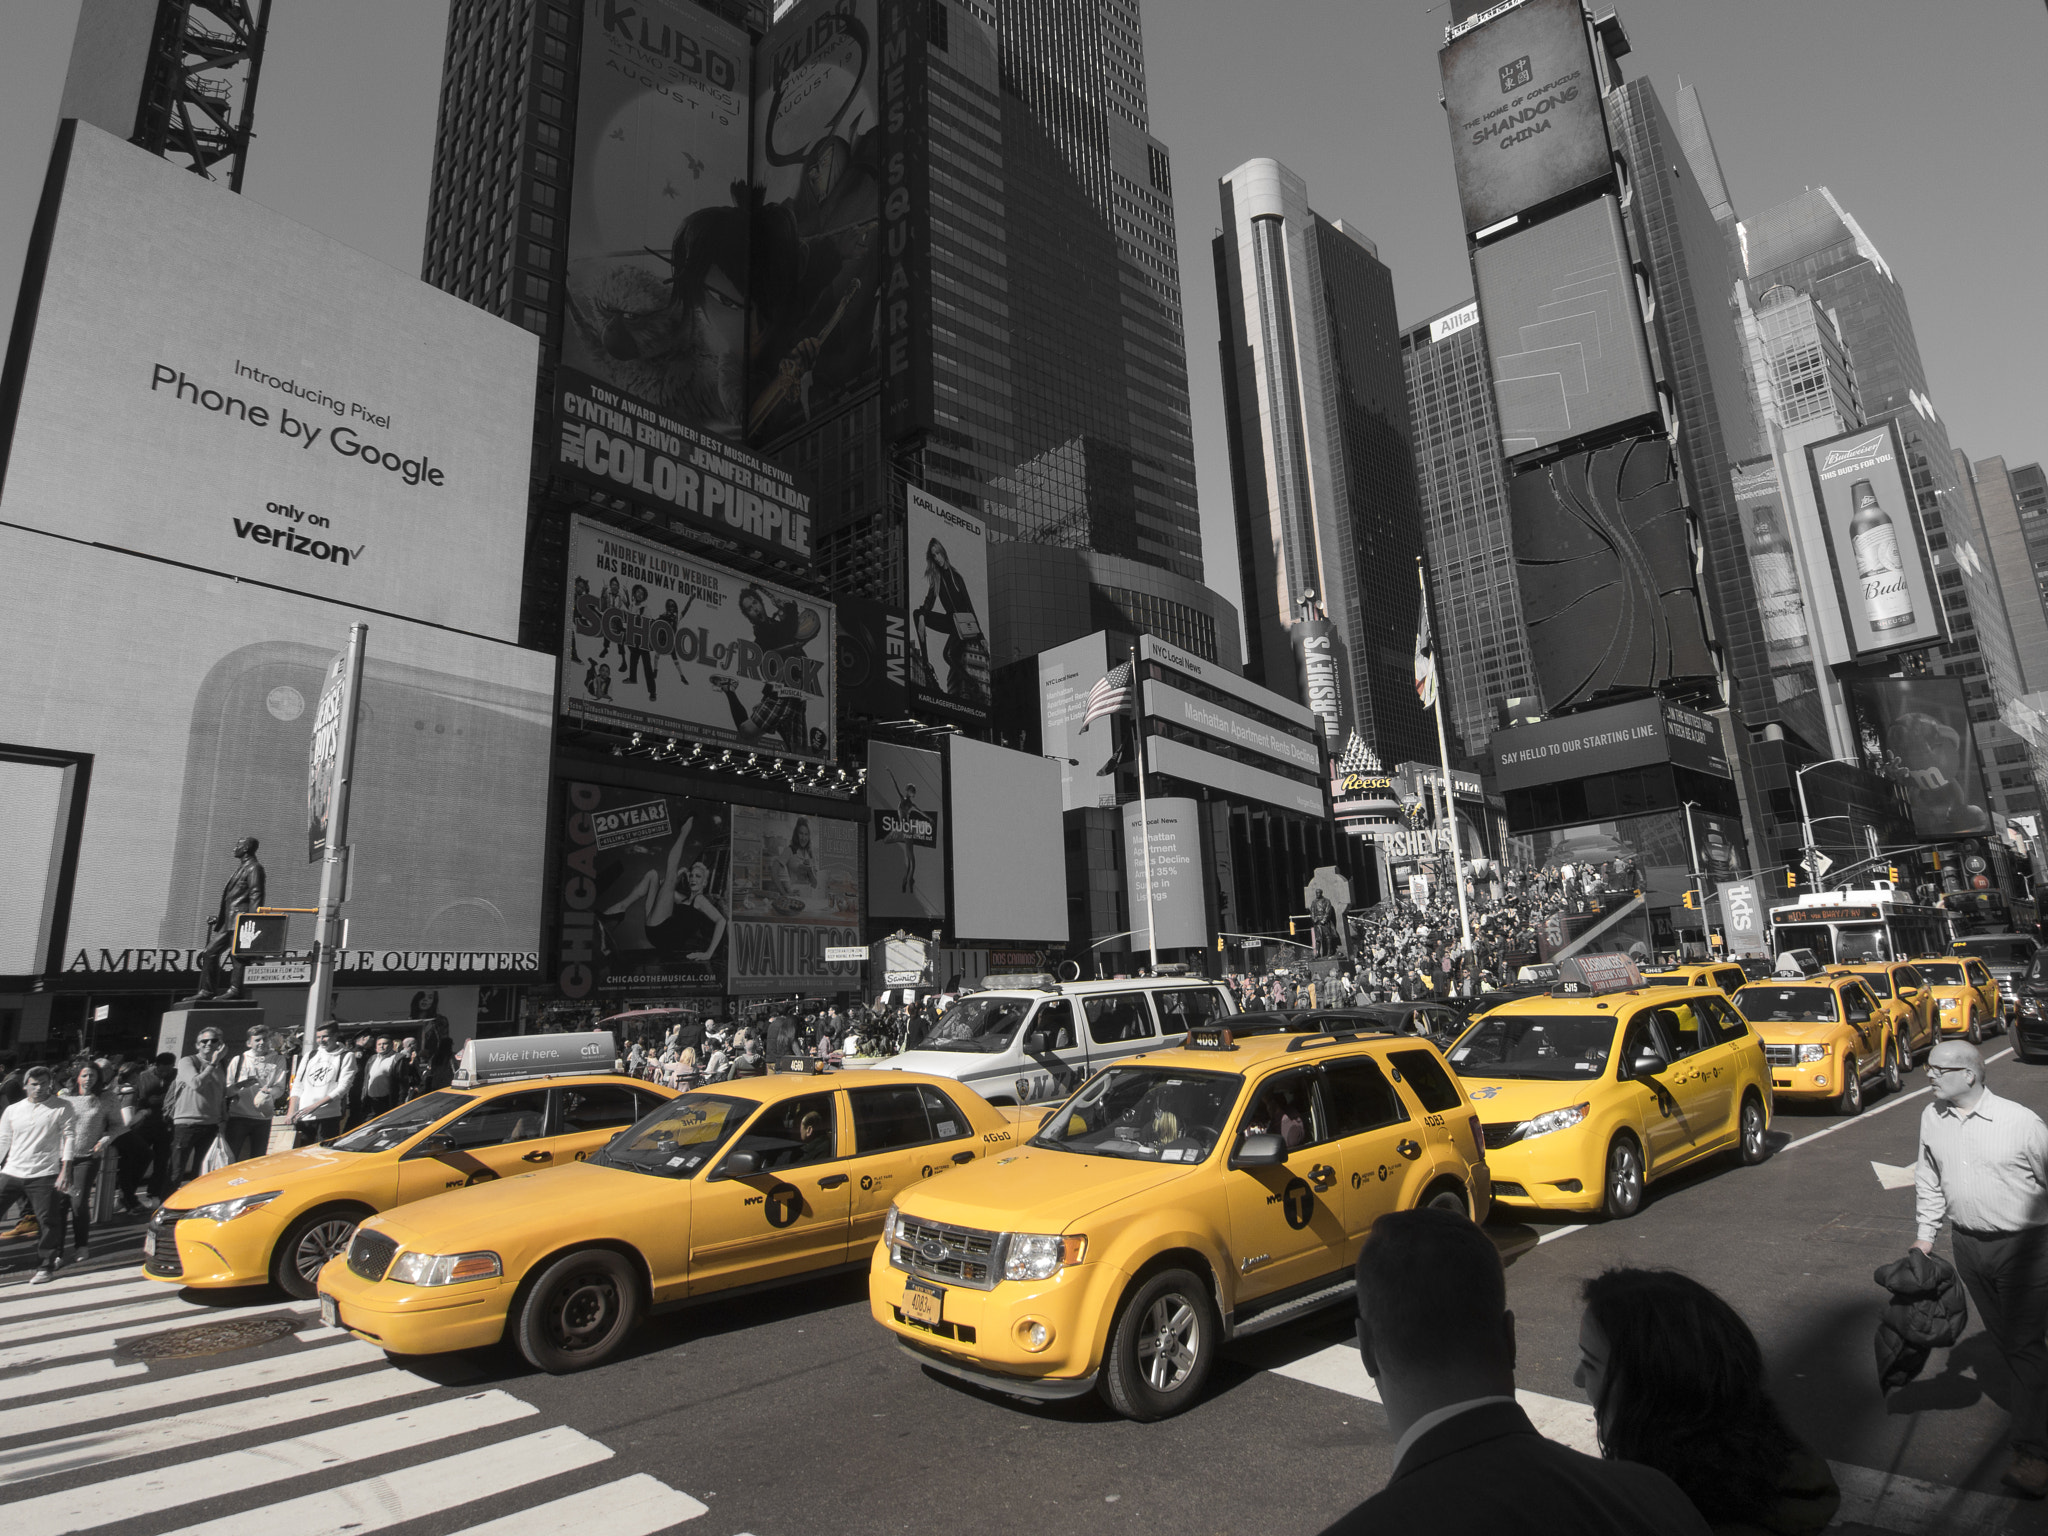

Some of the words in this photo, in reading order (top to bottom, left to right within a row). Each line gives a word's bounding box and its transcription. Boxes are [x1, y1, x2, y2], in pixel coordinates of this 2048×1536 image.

[603, 0, 735, 91] KUBO
[625, 42, 663, 70] TWO
[667, 66, 732, 106] STRINGS
[605, 59, 700, 110] AUGUST
[711, 110, 730, 127] 19
[775, 67, 832, 122] AUGUST
[1463, 118, 1481, 131] THE
[1482, 104, 1509, 121] HOME
[1511, 97, 1524, 109] OF
[1526, 70, 1581, 101] CONFUCIUS
[1472, 86, 1580, 146] SHANDONG
[1499, 119, 1552, 150] CHINA
[884, 151, 911, 377] SQUARE
[234, 359, 346, 416] Introducing
[350, 402, 391, 430] Pixel
[150, 363, 271, 428] Phone
[279, 408, 321, 450] by
[329, 426, 445, 487] Google
[591, 385, 619, 408] TONY
[620, 397, 656, 424] AWARD
[658, 415, 699, 443] WINNER!
[700, 429, 723, 453] BEST
[724, 445, 761, 472] MUSICAL
[762, 461, 794, 486] REVIVAL
[563, 392, 633, 438] CYNTHIA
[636, 421, 680, 457] ERIVO
[689, 446, 752, 487] JENNIFER
[754, 476, 811, 514] HOLLIDAY
[1820, 470, 1837, 481] THIS
[1837, 463, 1860, 476] BUD'S
[1860, 459, 1875, 469] FOR
[1875, 453, 1894, 464] YOU.
[1827, 443, 1879, 465] Budweiser
[560, 421, 586, 469] THE
[583, 427, 700, 513] COLOR
[703, 455, 811, 559] PURPLE
[265, 501, 305, 522] only
[307, 512, 331, 529] on
[913, 495, 935, 514] KARL
[936, 505, 981, 537] LAGERFELD
[233, 516, 350, 566] verizon
[597, 554, 618, 573] HAS
[620, 561, 677, 592] BROADWAY
[650, 553, 680, 578] LLOYD
[682, 566, 719, 591] WEBBER
[575, 594, 718, 668] SCHOOL
[712, 638, 739, 671] of
[737, 637, 825, 698] ROCK
[886, 614, 906, 687] NEW
[1152, 643, 1168, 661] NYC
[1168, 650, 1185, 667] Local
[1185, 658, 1202, 674] News
[918, 693, 987, 720] KARLLAGERFELDPARIS.COM
[1184, 701, 1230, 732] Manhattan
[1231, 717, 1269, 748] Apartment
[1270, 732, 1291, 753] Rents
[1290, 742, 1315, 766] Decline
[1501, 751, 1518, 766] SAY
[1519, 746, 1548, 763] HELLO
[1548, 743, 1561, 756] TO
[1561, 739, 1582, 754] OUR
[1582, 729, 1630, 749] STARTING
[1631, 724, 1659, 740] LINE.
[1342, 773, 1392, 791] Reese's
[596, 815, 620, 833] 20
[618, 804, 665, 829] YEARS
[882, 816, 933, 836] StubHub
[1133, 832, 1176, 845] Mahattan
[1133, 843, 1177, 856] Aptment
[1134, 857, 1156, 867] Res
[1158, 854, 1190, 864] Decline
[1135, 867, 1155, 878] Amd
[1156, 866, 1178, 876] 35%
[560, 781, 602, 998] CHICAGO
[1136, 880, 1159, 890] Sue
[1161, 878, 1170, 888] in
[1728, 884, 1754, 931] tkts
[1822, 909, 1849, 919] BWAY/7
[1850, 908, 1861, 917] AV
[383, 950, 539, 973] OUTFITTERS
[992, 952, 1007, 965] DOS
[1007, 952, 1036, 965] CAMINOS
[1581, 955, 1625, 972] FLASHDANCERS
[606, 974, 717, 984] CHICAGOTHEMUSICAL.COM
[1564, 982, 1578, 993] 5J15
[1586, 969, 1617, 982] GENTLEMEN'S
[1617, 968, 1629, 978] CLUB
[581, 1045, 600, 1056] citi
[1196, 1032, 1219, 1047] 4D83
[488, 1052, 519, 1063] Make
[521, 1050, 529, 1060] it
[532, 1049, 560, 1059] here.
[790, 1060, 804, 1072] 4G60
[1424, 1113, 1445, 1128] 4D83
[446, 1179, 463, 1188] NYC
[744, 1196, 763, 1206] NYC
[1266, 1193, 1283, 1205] NYC
